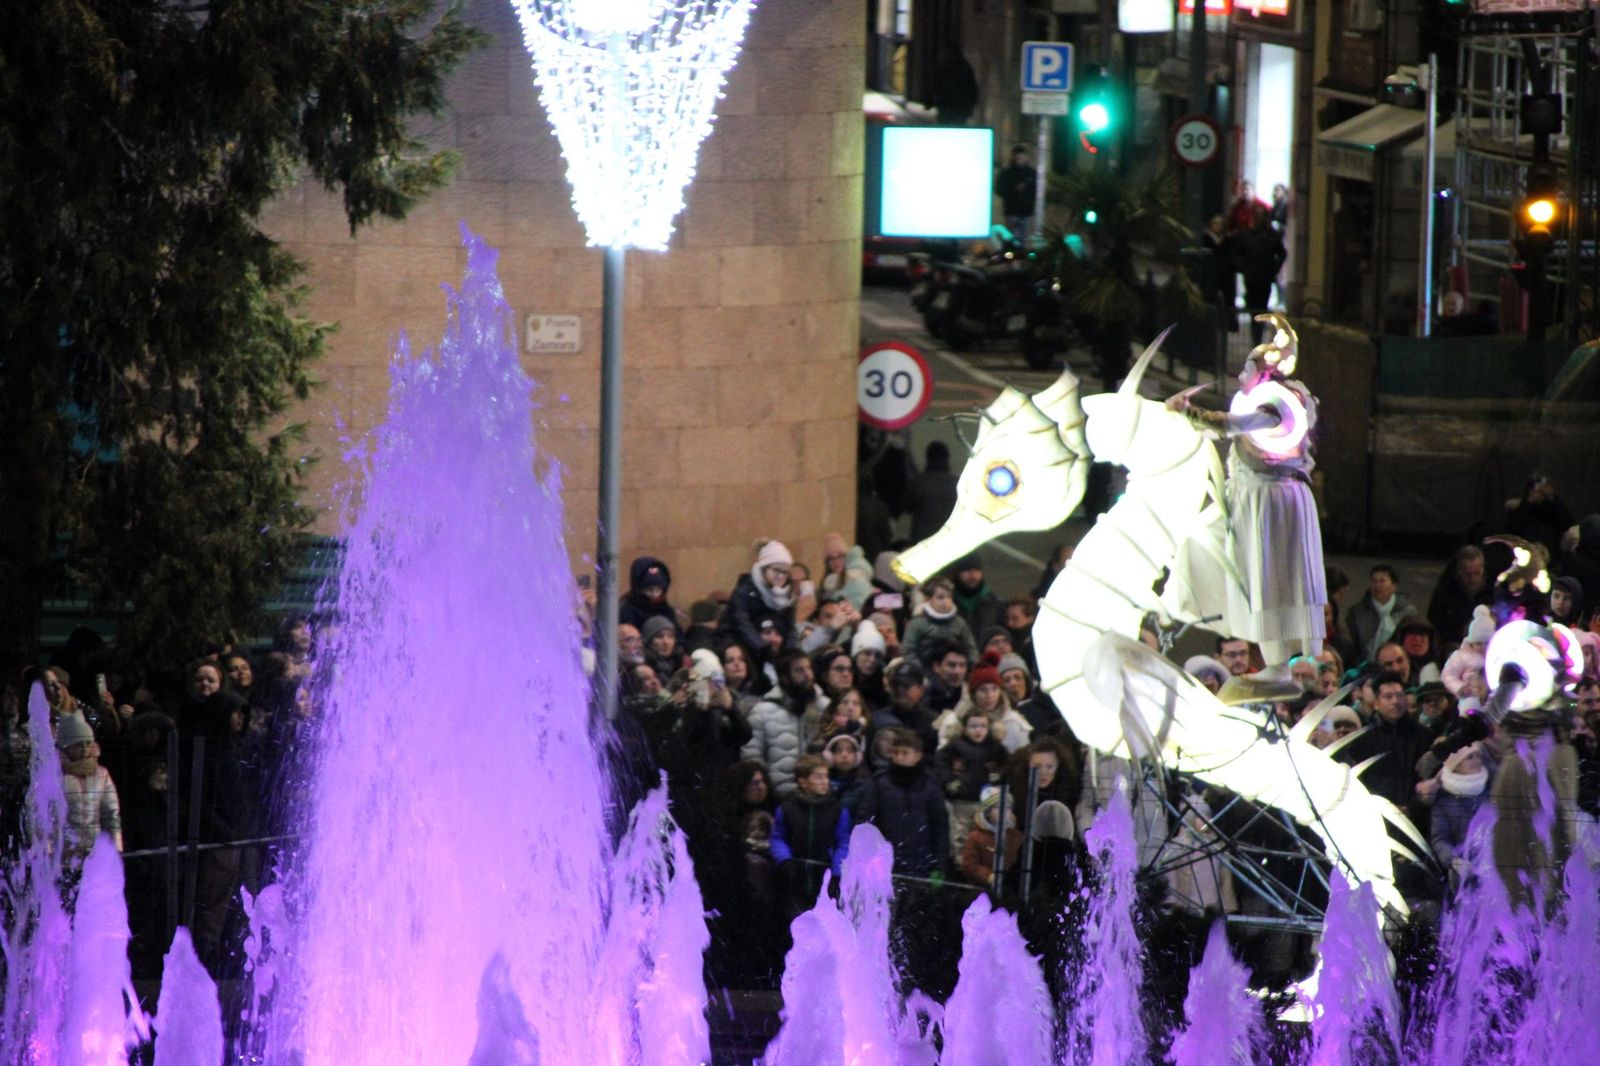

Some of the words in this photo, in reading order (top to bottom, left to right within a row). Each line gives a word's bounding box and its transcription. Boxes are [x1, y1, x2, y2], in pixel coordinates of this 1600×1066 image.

[1031, 47, 1062, 86] P
[1182, 132, 1210, 150] 30
[864, 368, 913, 399] 30
